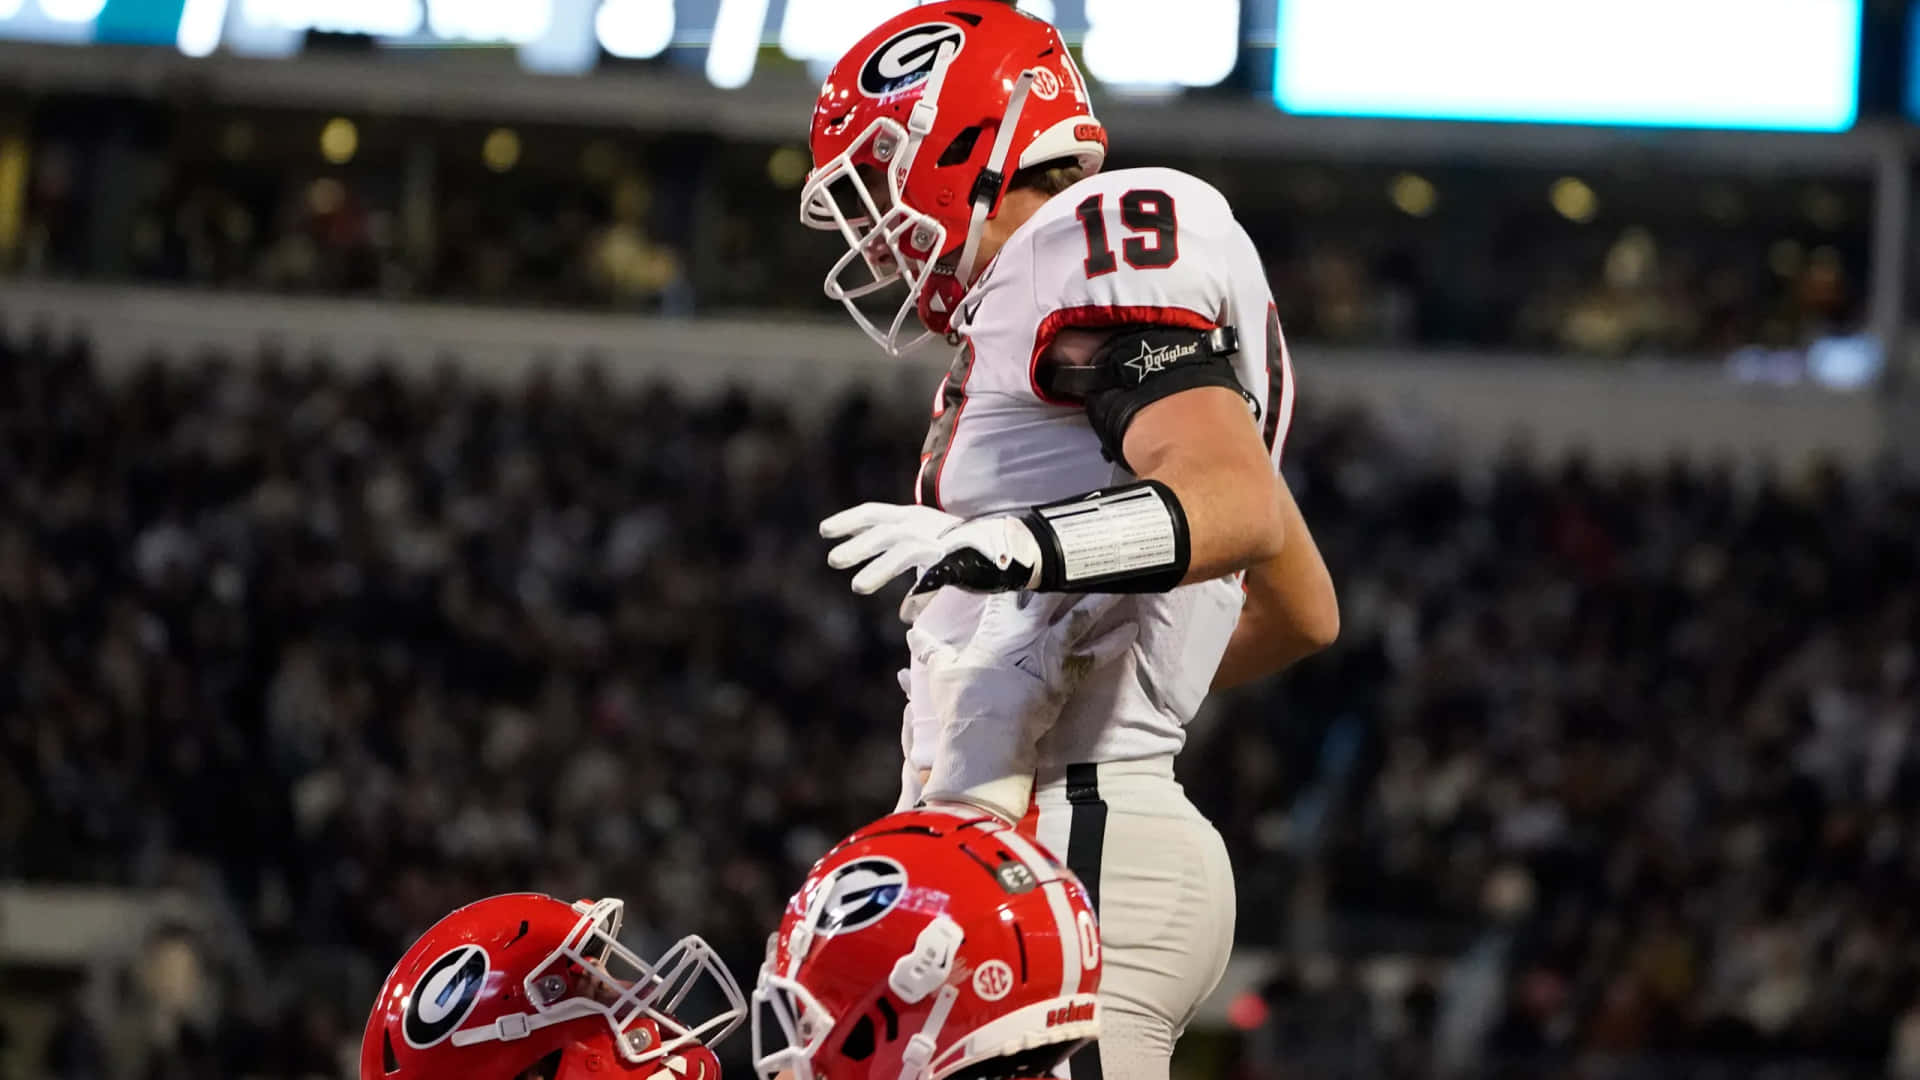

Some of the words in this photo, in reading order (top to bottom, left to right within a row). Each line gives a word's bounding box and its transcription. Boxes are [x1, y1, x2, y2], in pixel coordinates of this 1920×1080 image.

[1076, 189, 1179, 280] 19
[1144, 344, 1196, 369] Douglas
[976, 963, 1010, 998] SEC
